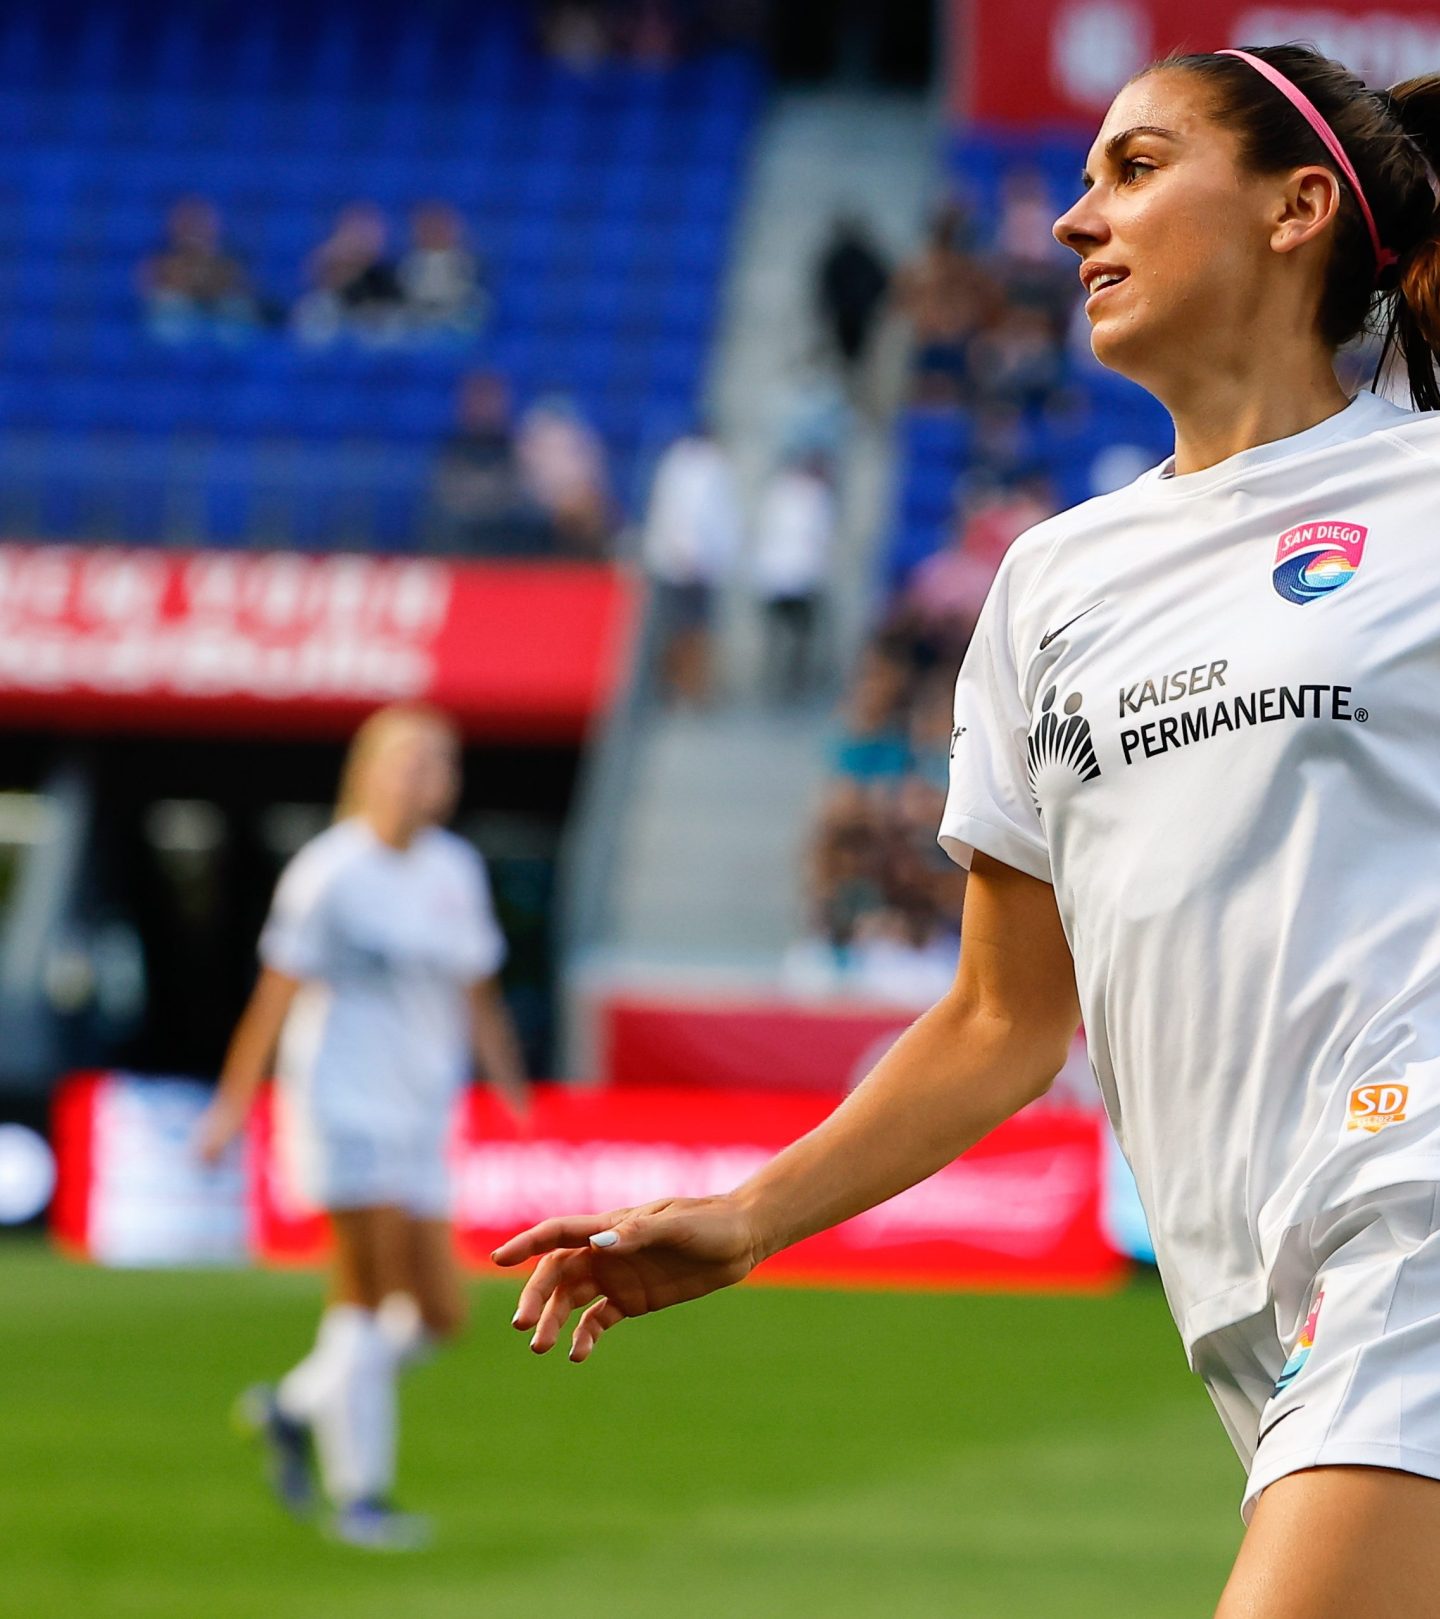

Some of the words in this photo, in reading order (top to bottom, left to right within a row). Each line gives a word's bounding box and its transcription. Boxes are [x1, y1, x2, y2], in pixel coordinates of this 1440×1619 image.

[1281, 527, 1313, 551] SAN
[1316, 525, 1361, 544] DIEGO
[1119, 659, 1228, 718] KAISER
[1354, 1088, 1403, 1116] SD
